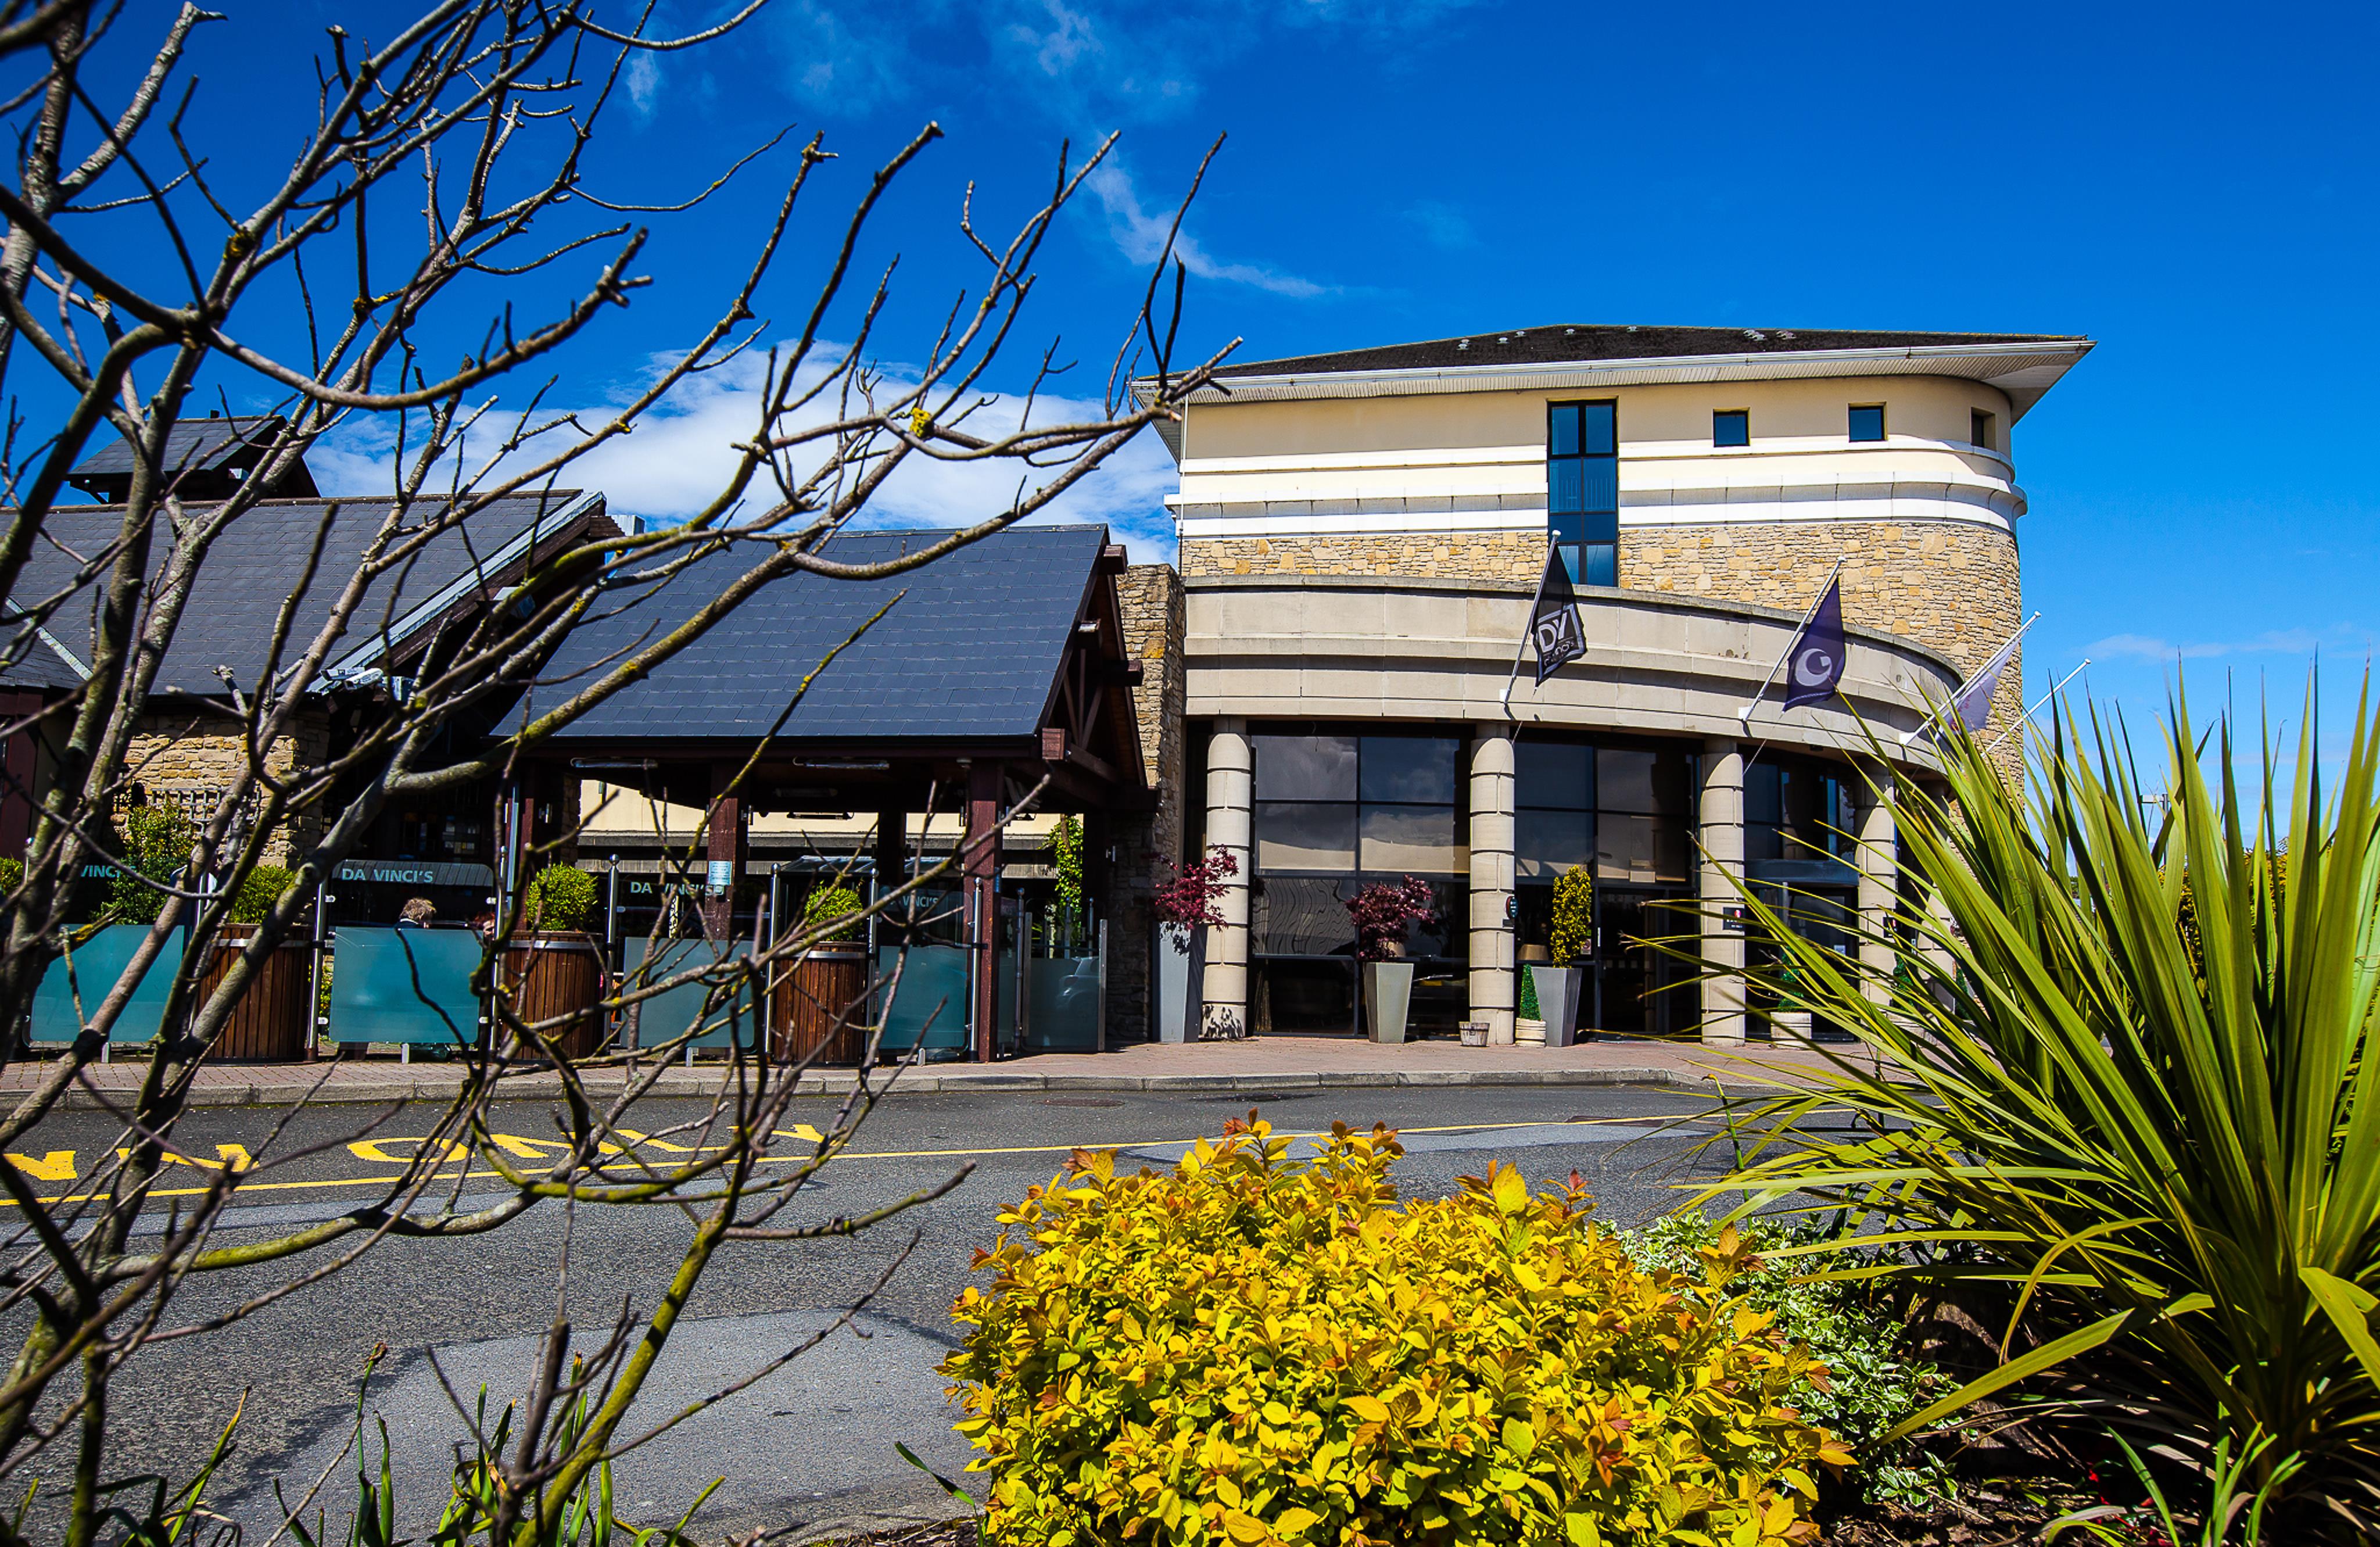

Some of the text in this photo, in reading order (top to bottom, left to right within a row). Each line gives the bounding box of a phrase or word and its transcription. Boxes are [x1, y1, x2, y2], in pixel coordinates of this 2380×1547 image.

[342, 868, 433, 883] DA VINCI'S
[630, 882, 653, 893] DA
[902, 896, 940, 907] VNCI'S
[347, 1123, 850, 1163] ONLY
